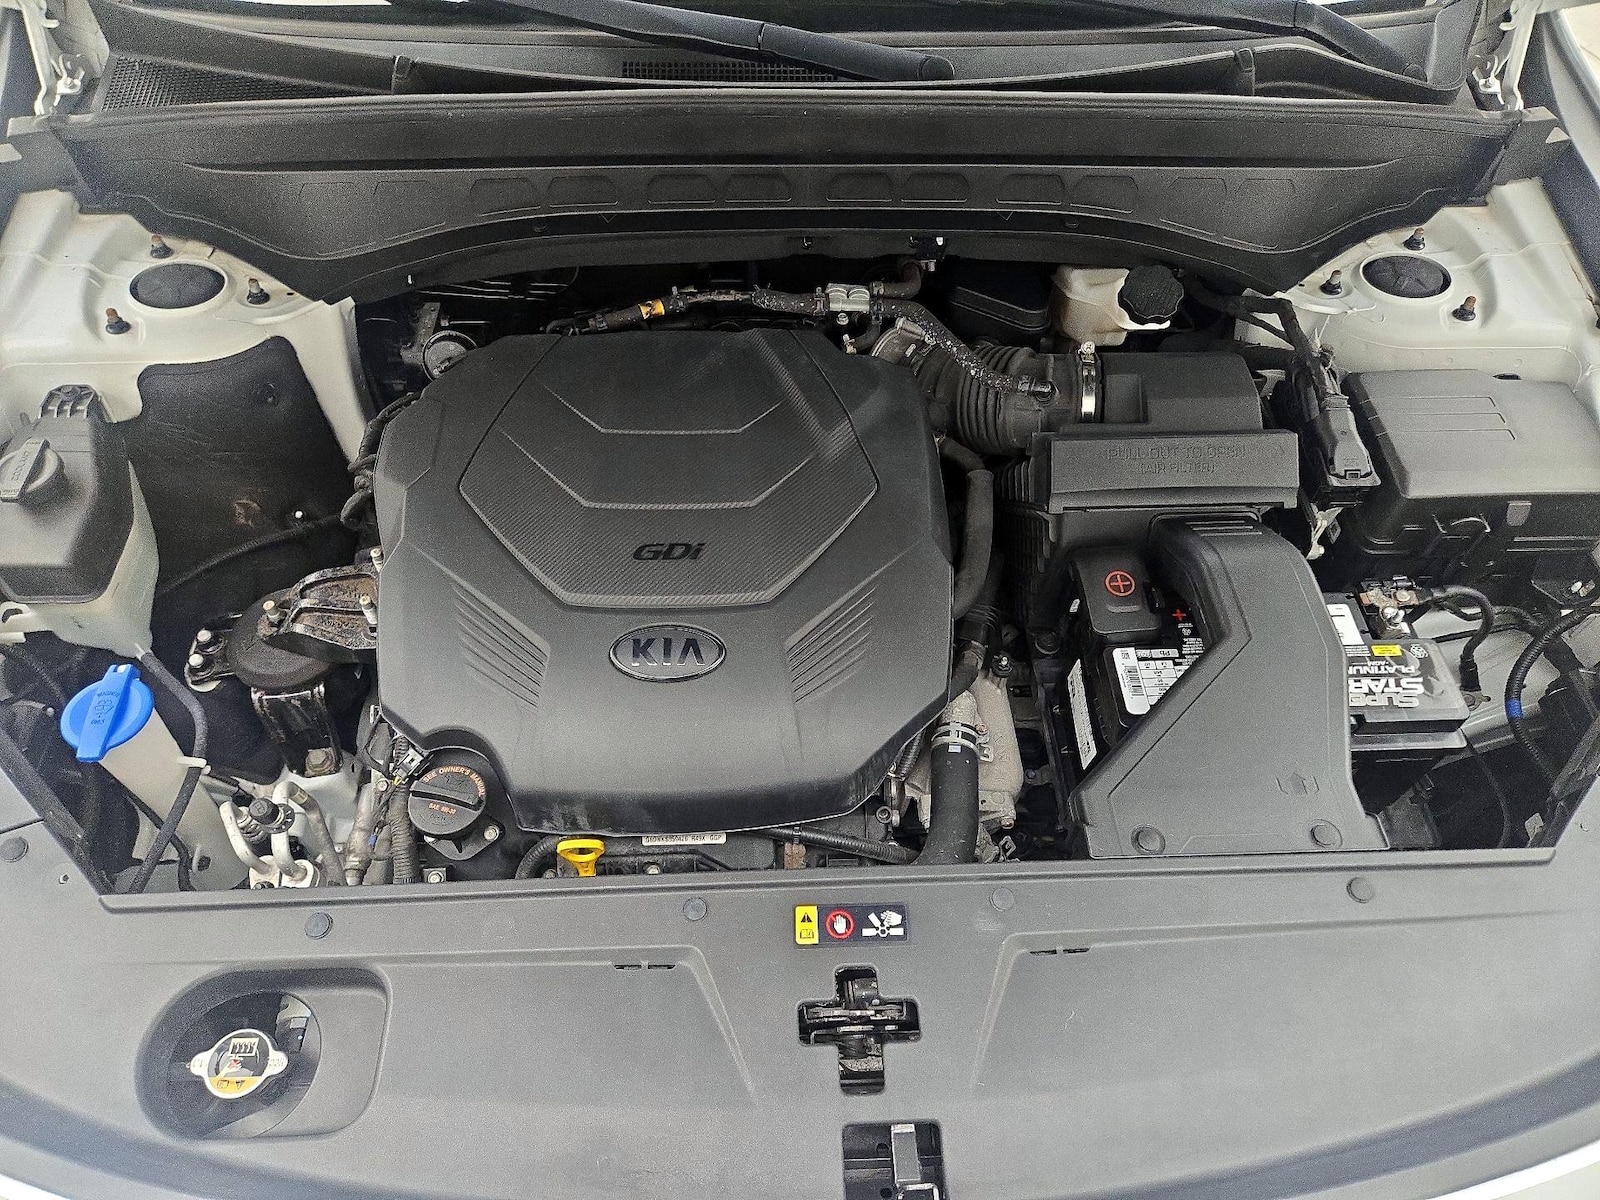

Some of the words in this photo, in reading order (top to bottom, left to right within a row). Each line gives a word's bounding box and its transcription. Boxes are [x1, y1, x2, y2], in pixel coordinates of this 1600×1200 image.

[633, 543, 706, 560] GDi
[631, 637, 706, 667] KIA
[1348, 677, 1424, 694] STAR
[1349, 692, 1419, 708] SUPE
[422, 770, 438, 783] SEE
[438, 765, 471, 775] OWNER'S
